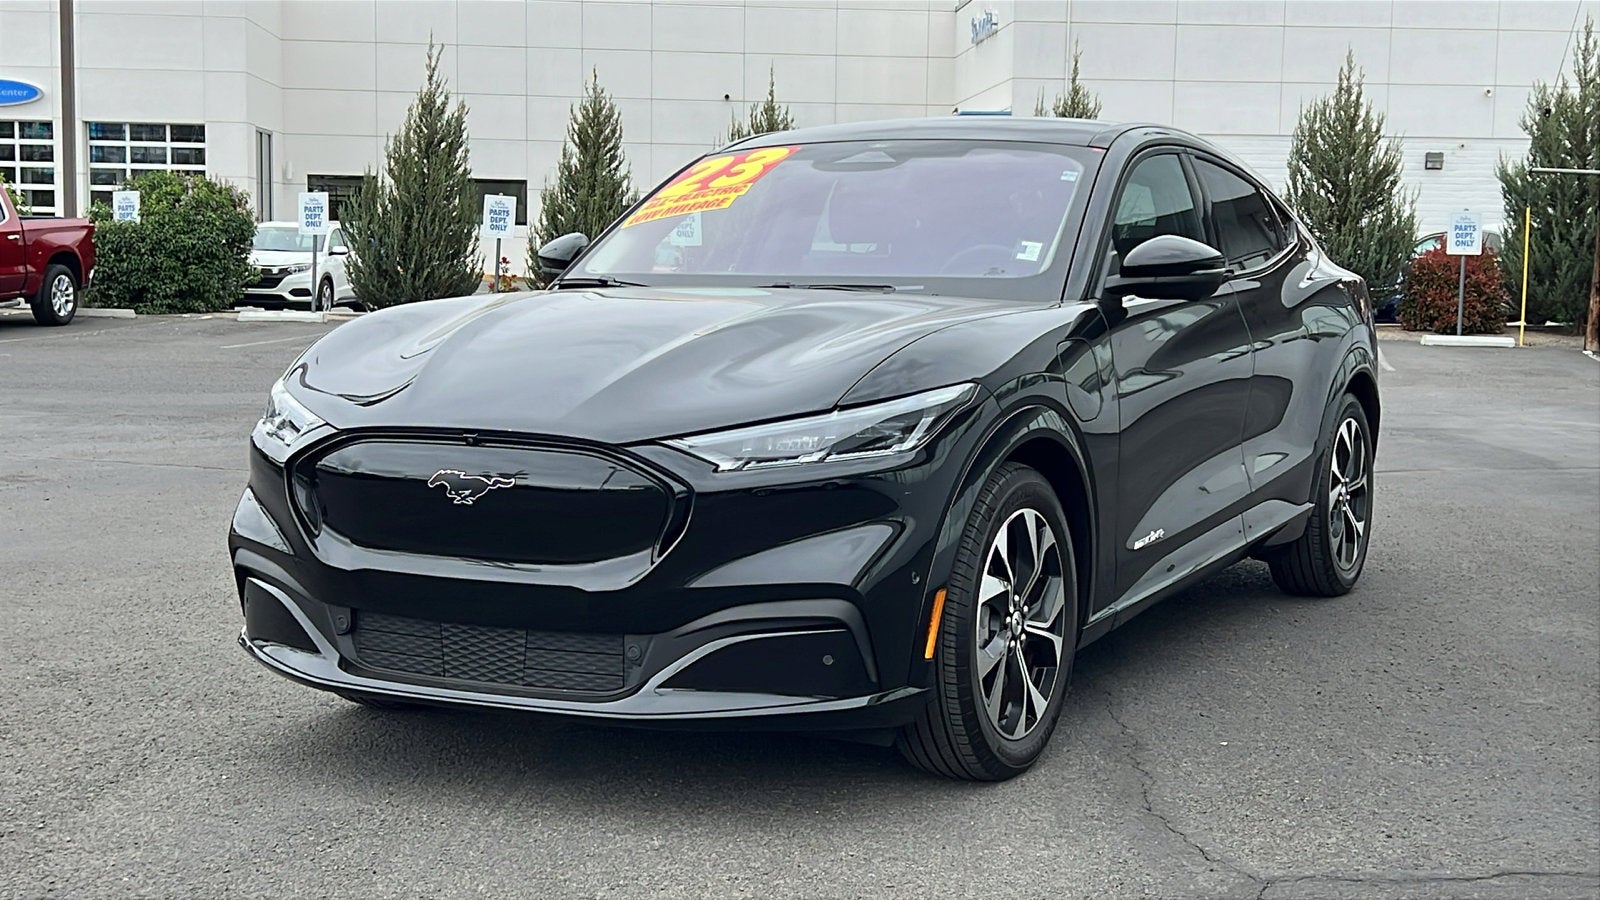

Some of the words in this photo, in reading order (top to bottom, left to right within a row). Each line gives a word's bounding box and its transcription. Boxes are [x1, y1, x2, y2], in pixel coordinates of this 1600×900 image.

[0, 89, 29, 97] enter
[656, 147, 790, 199] 23
[117, 204, 136, 212] PARTS
[628, 209, 662, 225] LOW
[660, 197, 730, 217] MILEAGE
[489, 208, 510, 217] PARTS
[305, 220, 322, 228] ONLY
[489, 223, 507, 232] ONLY
[1454, 224, 1477, 232] PARTS
[676, 230, 694, 239] ONLY
[1455, 239, 1475, 247] ONLY
